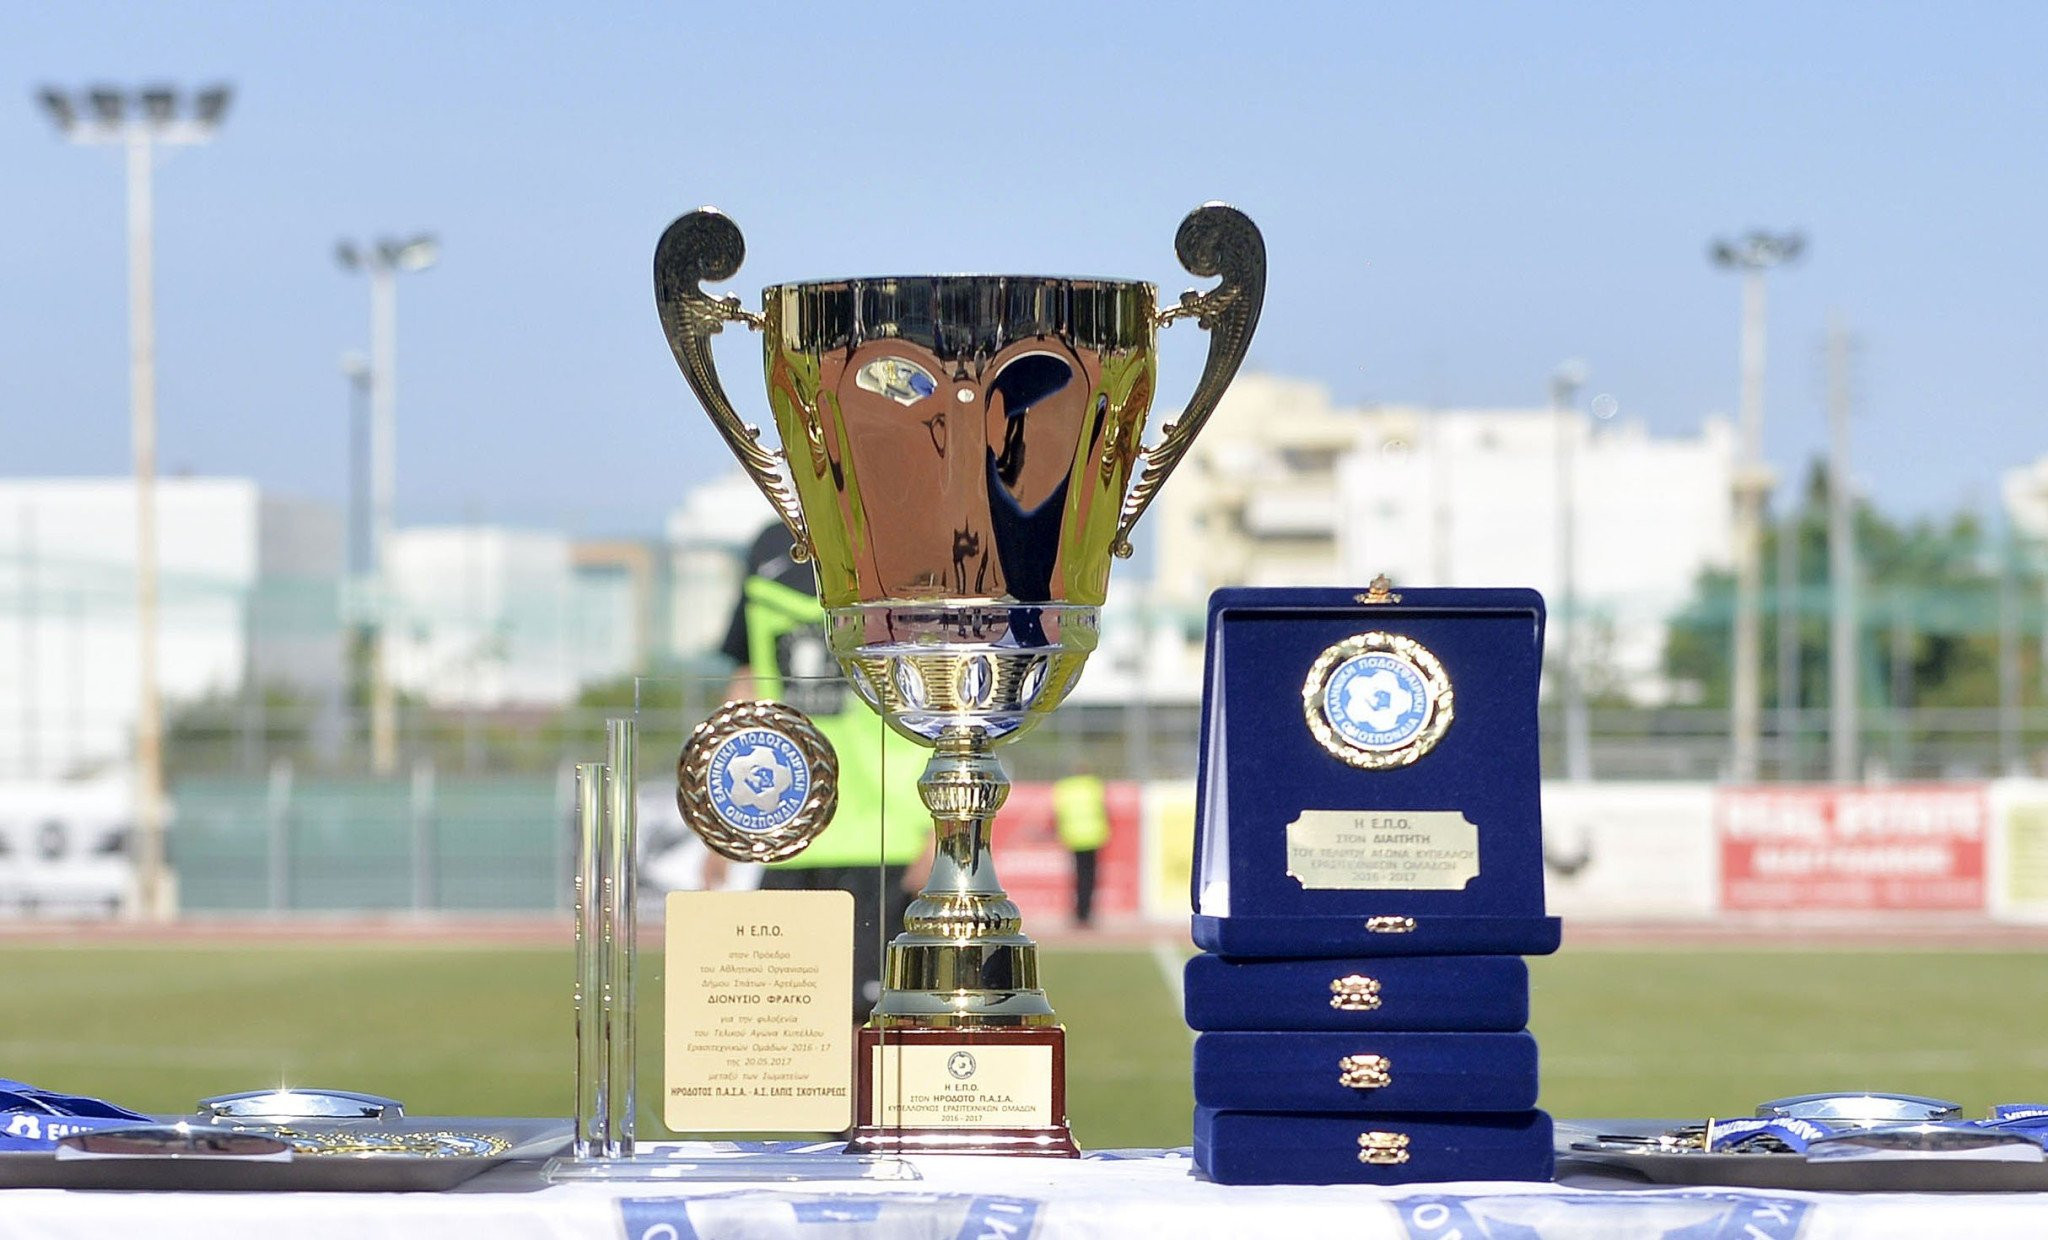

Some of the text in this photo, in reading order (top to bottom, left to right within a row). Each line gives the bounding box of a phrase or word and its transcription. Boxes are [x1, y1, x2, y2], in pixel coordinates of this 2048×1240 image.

[1371, 818, 1411, 830] Ε.Π.Ο.
[736, 925, 783, 937] Η Ε.Π.Ο.
[700, 966, 715, 974] του
[707, 994, 812, 1004] ΔΙΟΝΥΣΙΟ ΦΡΑΓΚΟ
[694, 1029, 709, 1037] του
[821, 1042, 831, 1051] 17
[743, 1072, 757, 1080] των
[671, 1087, 712, 1097] ΗΡΟΔΟΤΟΣ
[716, 1087, 747, 1097] Π.Α.Σ.Α.
[796, 1087, 846, 1097] ΣΚΟΥΤΑΡΕΩΣ
[955, 1084, 979, 1092] Ε.Π.Ο.
[979, 1095, 1013, 1103] Π.Α.Σ.Α.
